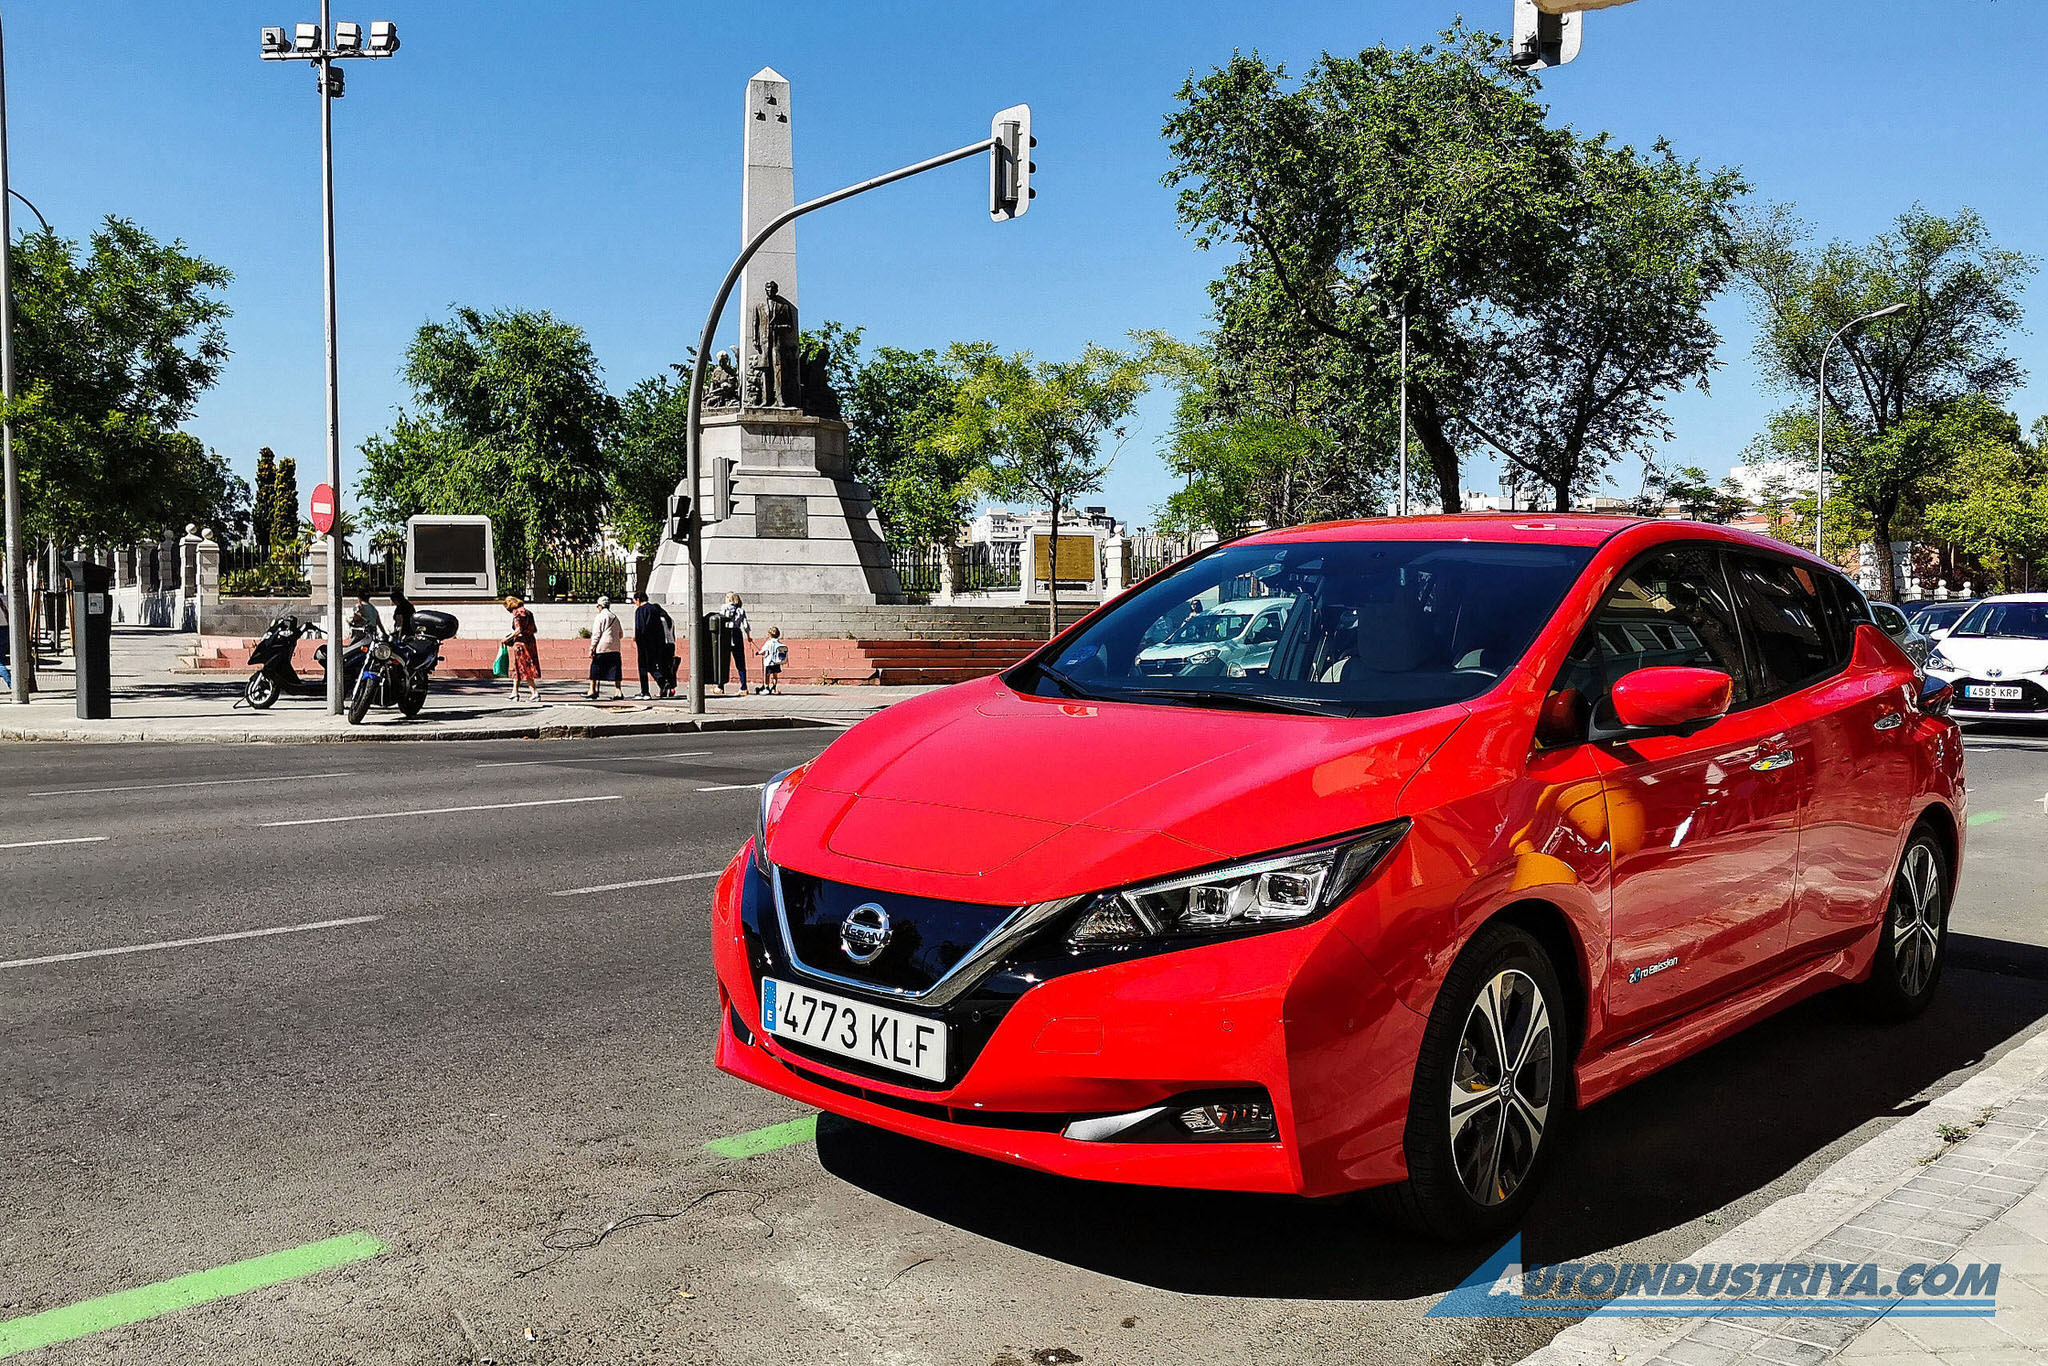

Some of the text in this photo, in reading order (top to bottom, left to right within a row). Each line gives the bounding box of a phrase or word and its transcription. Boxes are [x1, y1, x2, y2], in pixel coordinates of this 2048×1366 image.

[1972, 687, 2019, 698] 4585 KRP
[767, 1010, 773, 1022] E
[783, 991, 935, 1068] 4773 KLF
